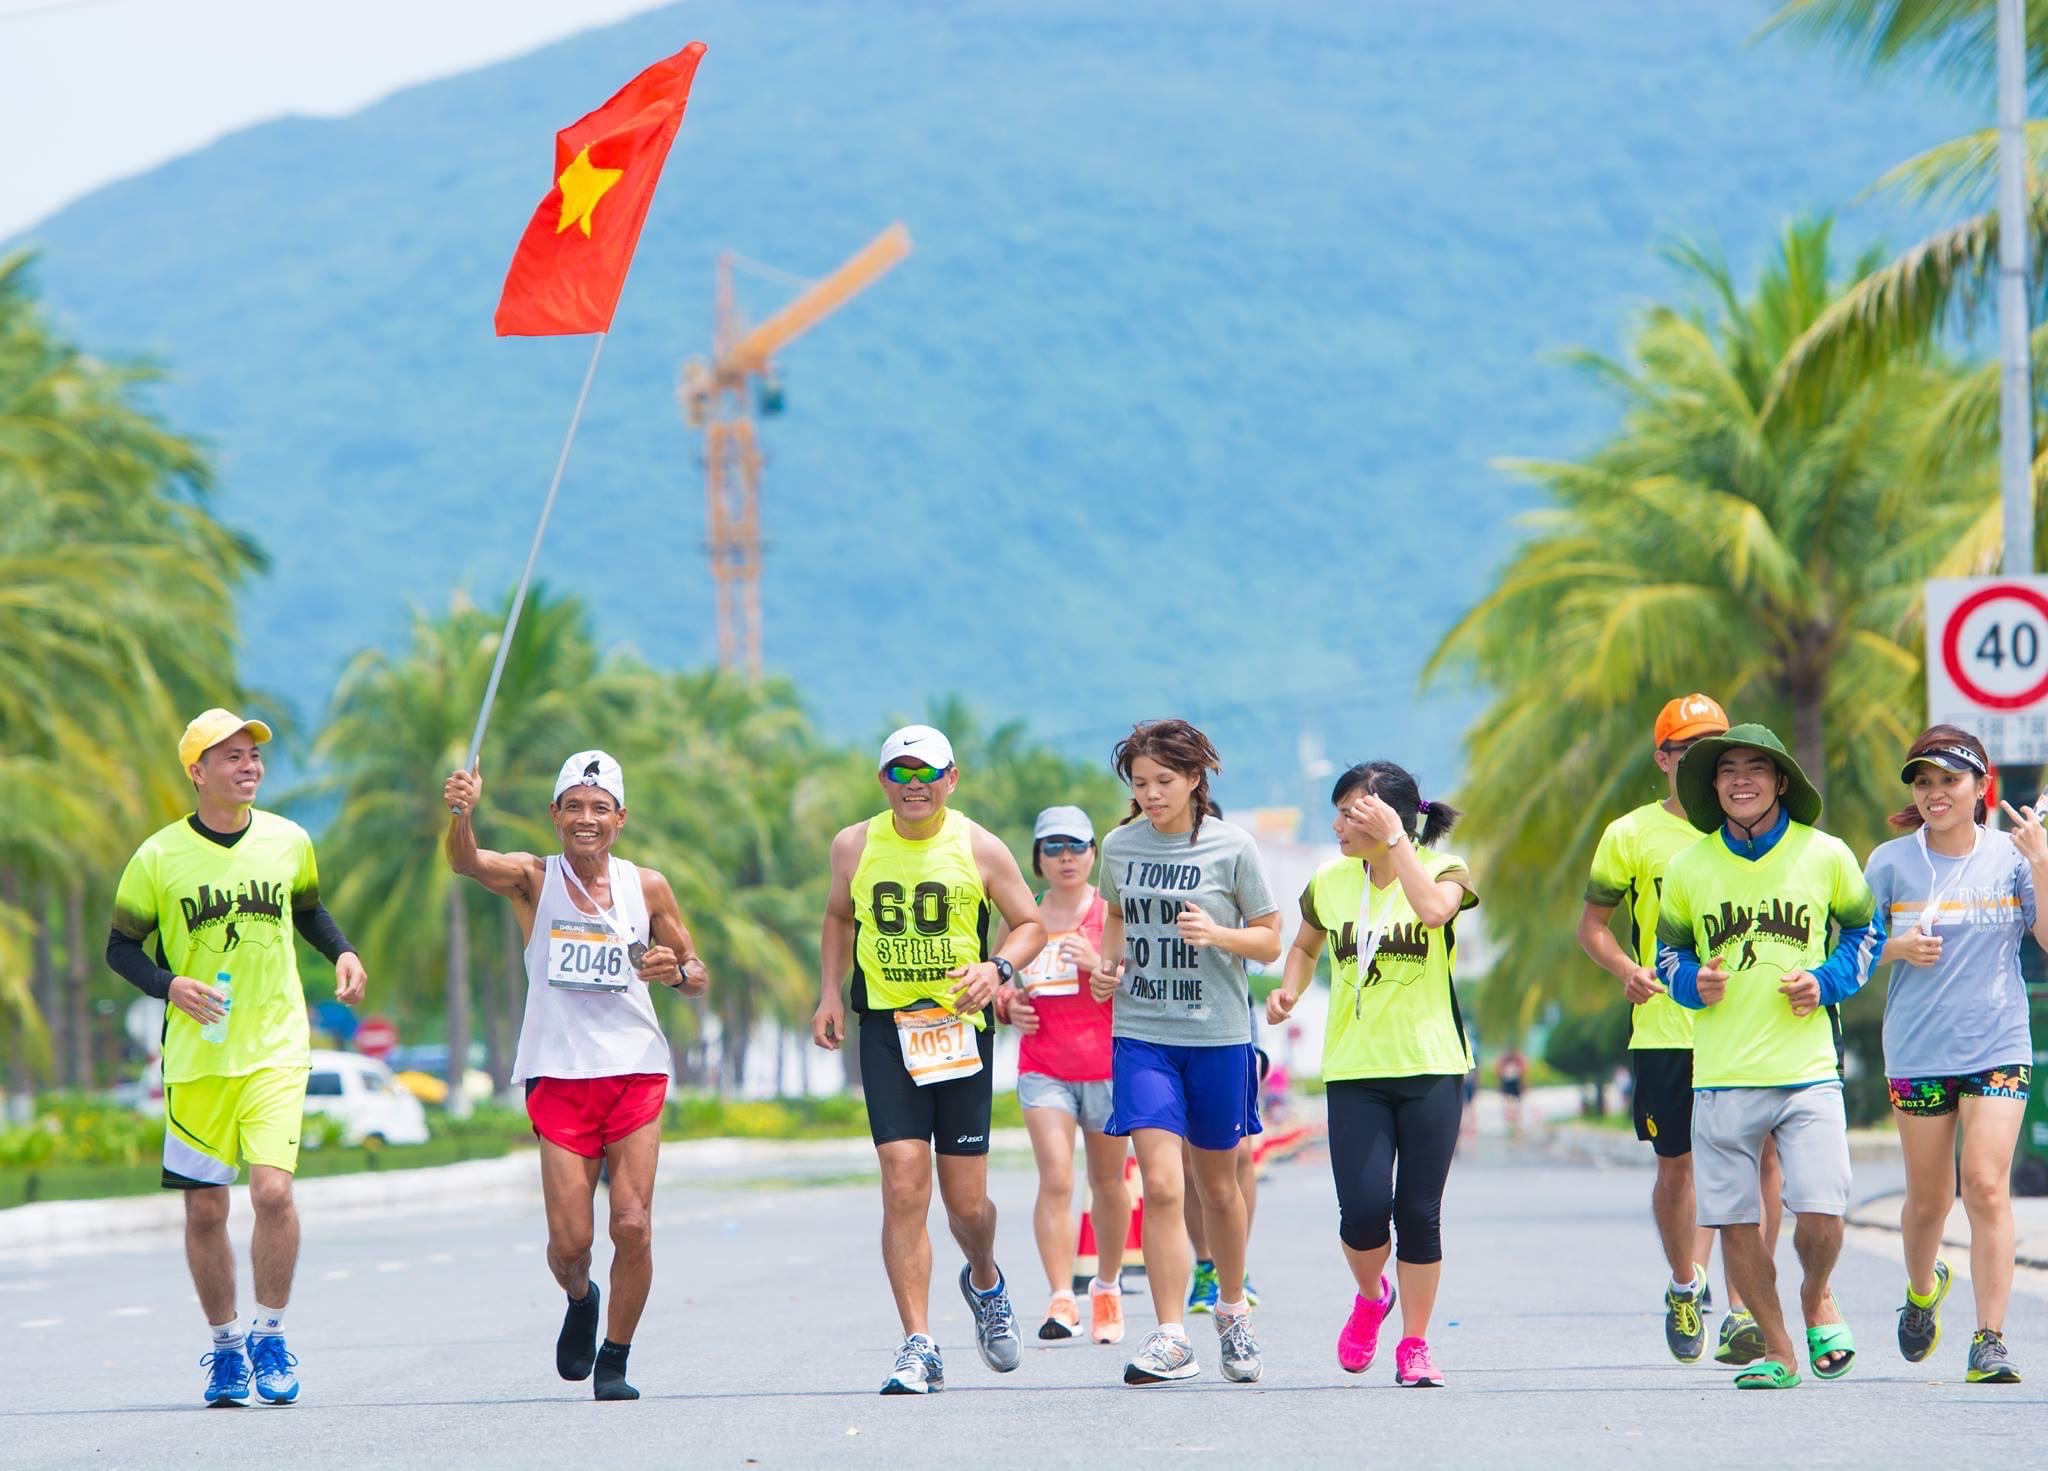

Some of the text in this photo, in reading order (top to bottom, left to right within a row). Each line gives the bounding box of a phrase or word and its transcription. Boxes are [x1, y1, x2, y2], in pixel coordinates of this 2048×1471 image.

[1976, 621, 2038, 668] 40
[1126, 862, 1201, 890] I TOWED
[180, 880, 284, 934] DANANG
[869, 881, 971, 936] 60+
[1125, 898, 1190, 924] MY DA
[1703, 898, 1811, 955] DANANG
[875, 938, 956, 964] STILL
[1126, 937, 1198, 968] TO THE
[1722, 934, 1739, 949] FOR
[1774, 931, 1808, 952] DANANG
[560, 942, 622, 976] 2046
[882, 967, 955, 982] RUNNIN
[1173, 980, 1202, 1000] LINE
[909, 1022, 963, 1057] 4057
[966, 1135, 984, 1143] asics
